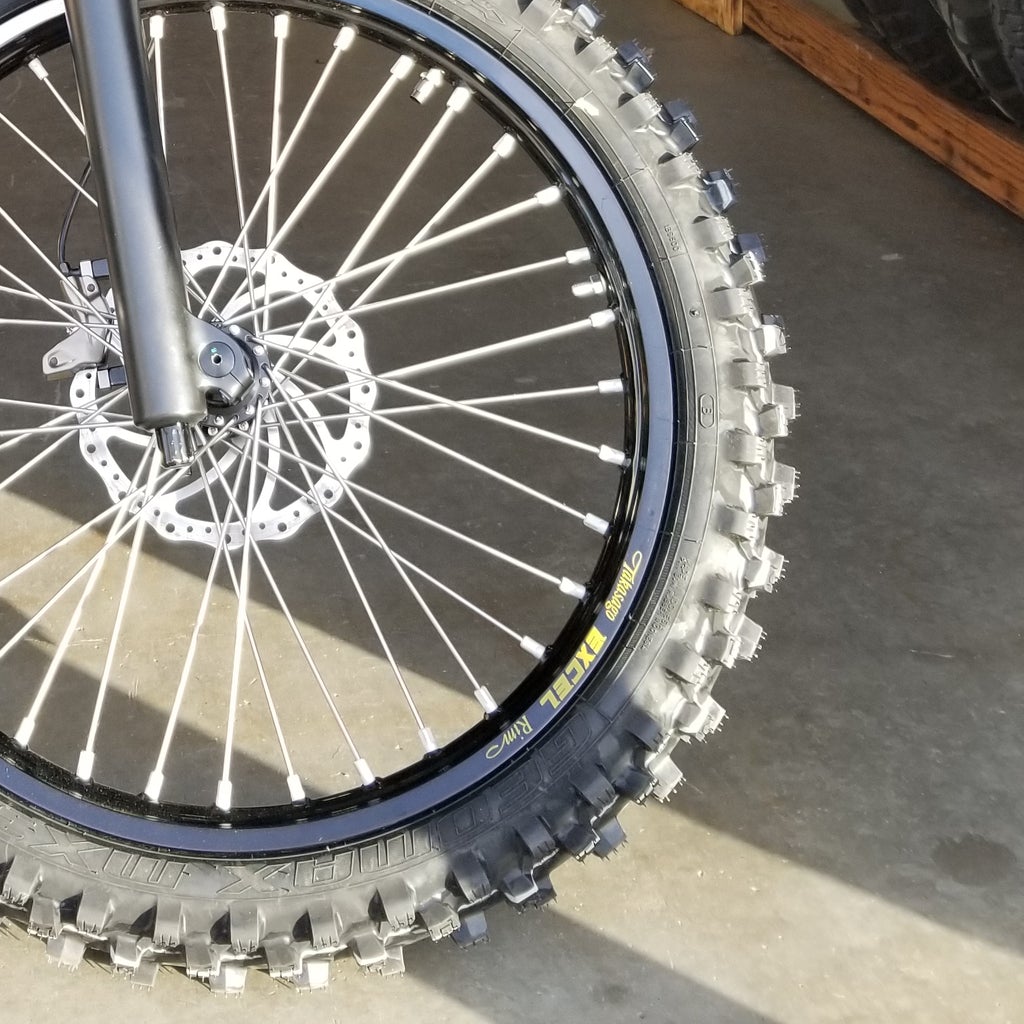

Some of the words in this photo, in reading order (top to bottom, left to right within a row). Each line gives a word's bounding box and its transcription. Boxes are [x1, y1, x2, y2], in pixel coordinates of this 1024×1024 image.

[604, 550, 643, 622] Takasago
[539, 626, 608, 709] EXCEL
[485, 715, 534, 760] Rim
